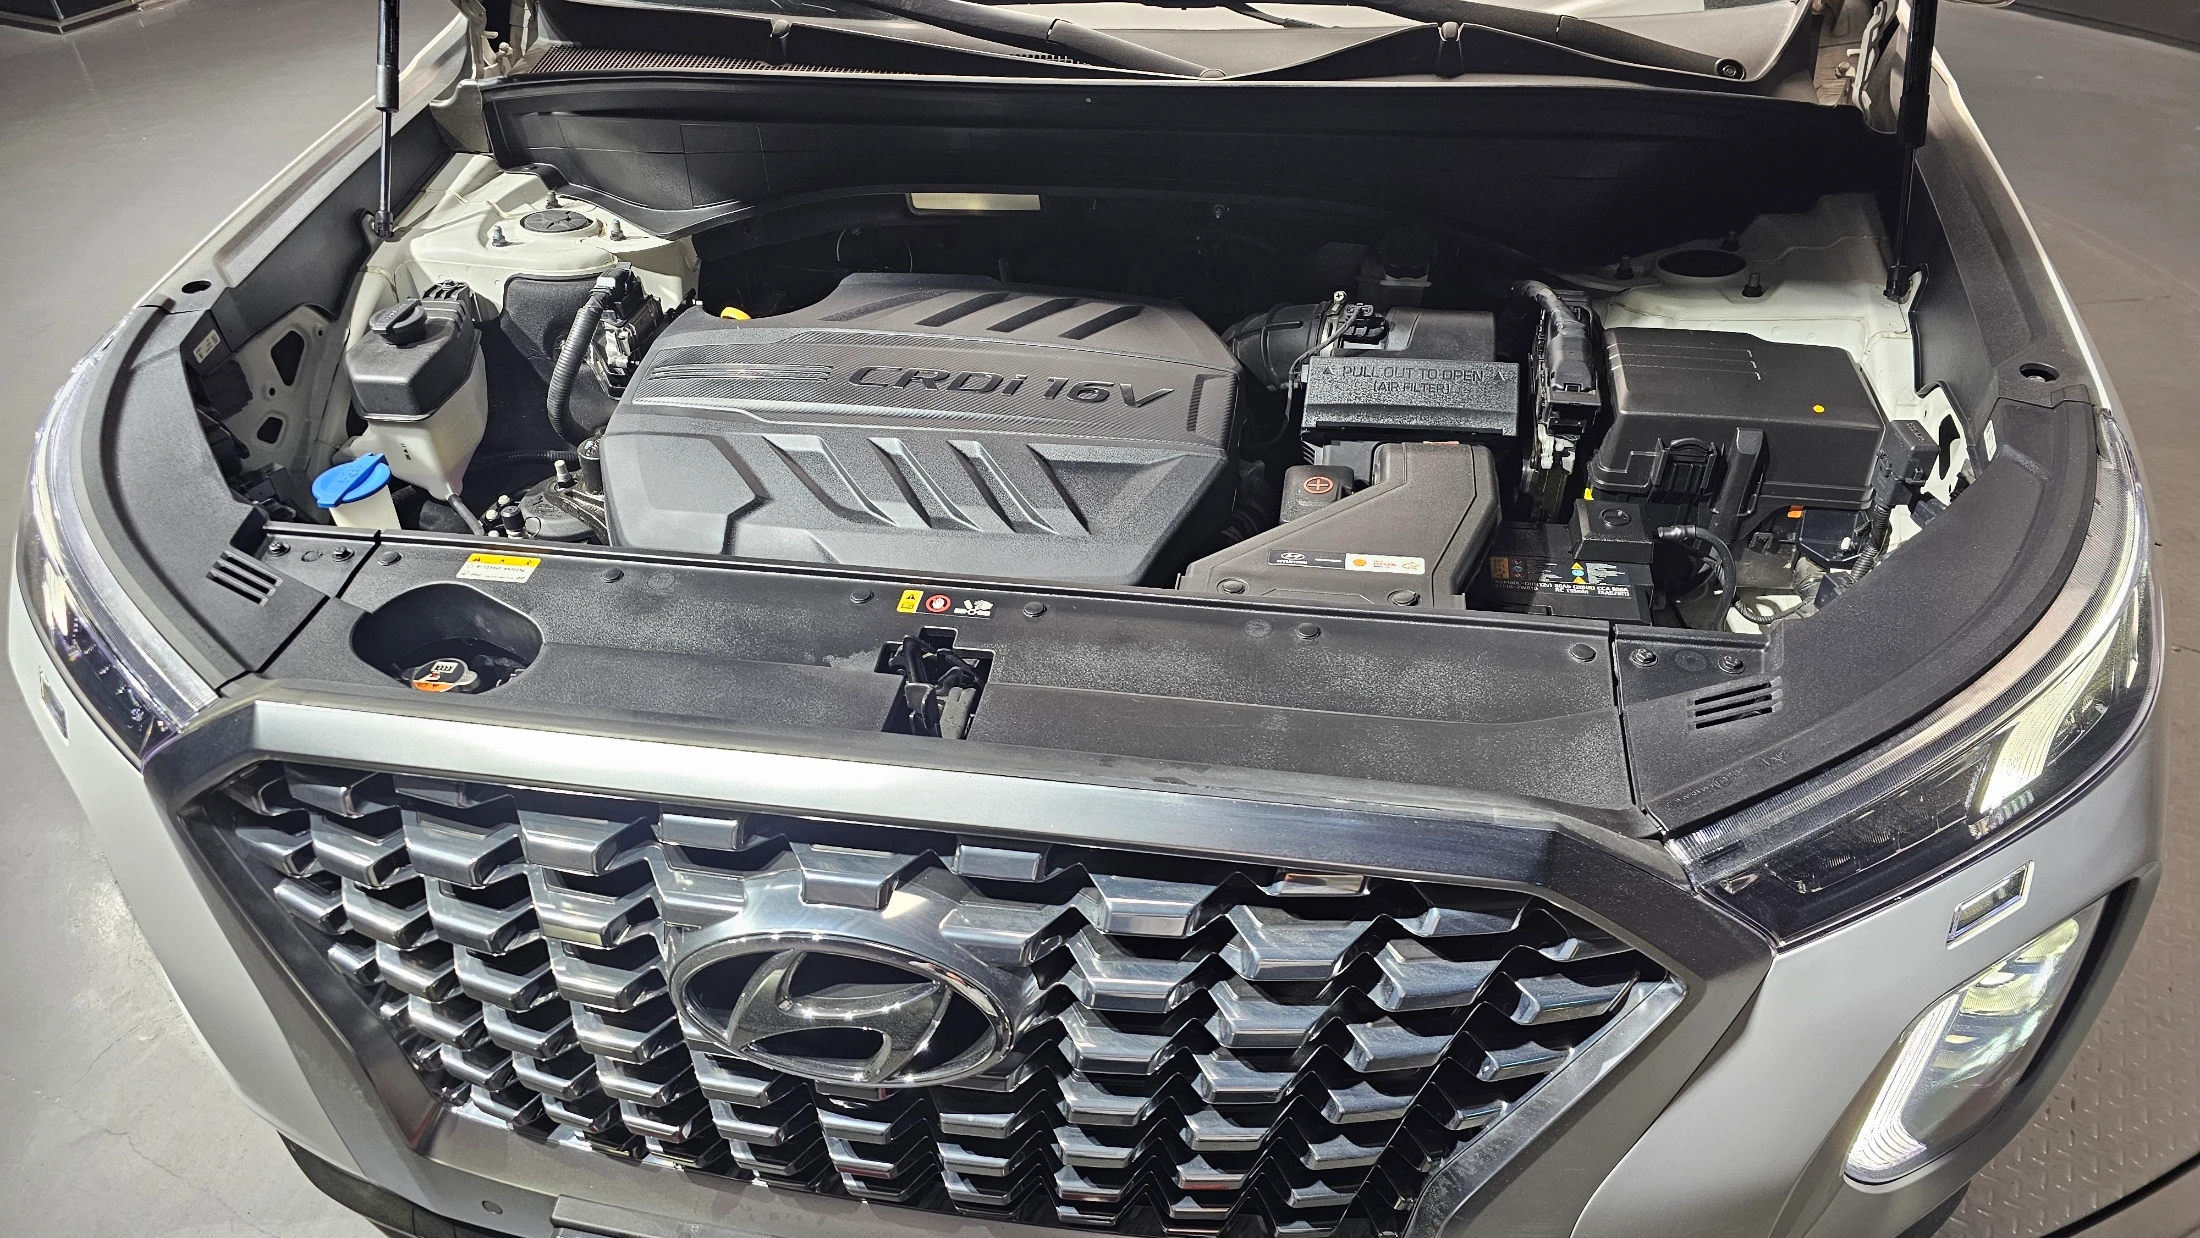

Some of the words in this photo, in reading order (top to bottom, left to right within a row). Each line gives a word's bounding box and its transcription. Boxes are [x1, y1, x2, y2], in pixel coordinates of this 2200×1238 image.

[848, 365, 1028, 397] CRDi
[1042, 376, 1175, 408] 16V
[1342, 365, 1379, 379] PULL
[1383, 366, 1414, 380] OUT
[1419, 368, 1438, 380] TO
[1442, 369, 1484, 382] OPEN
